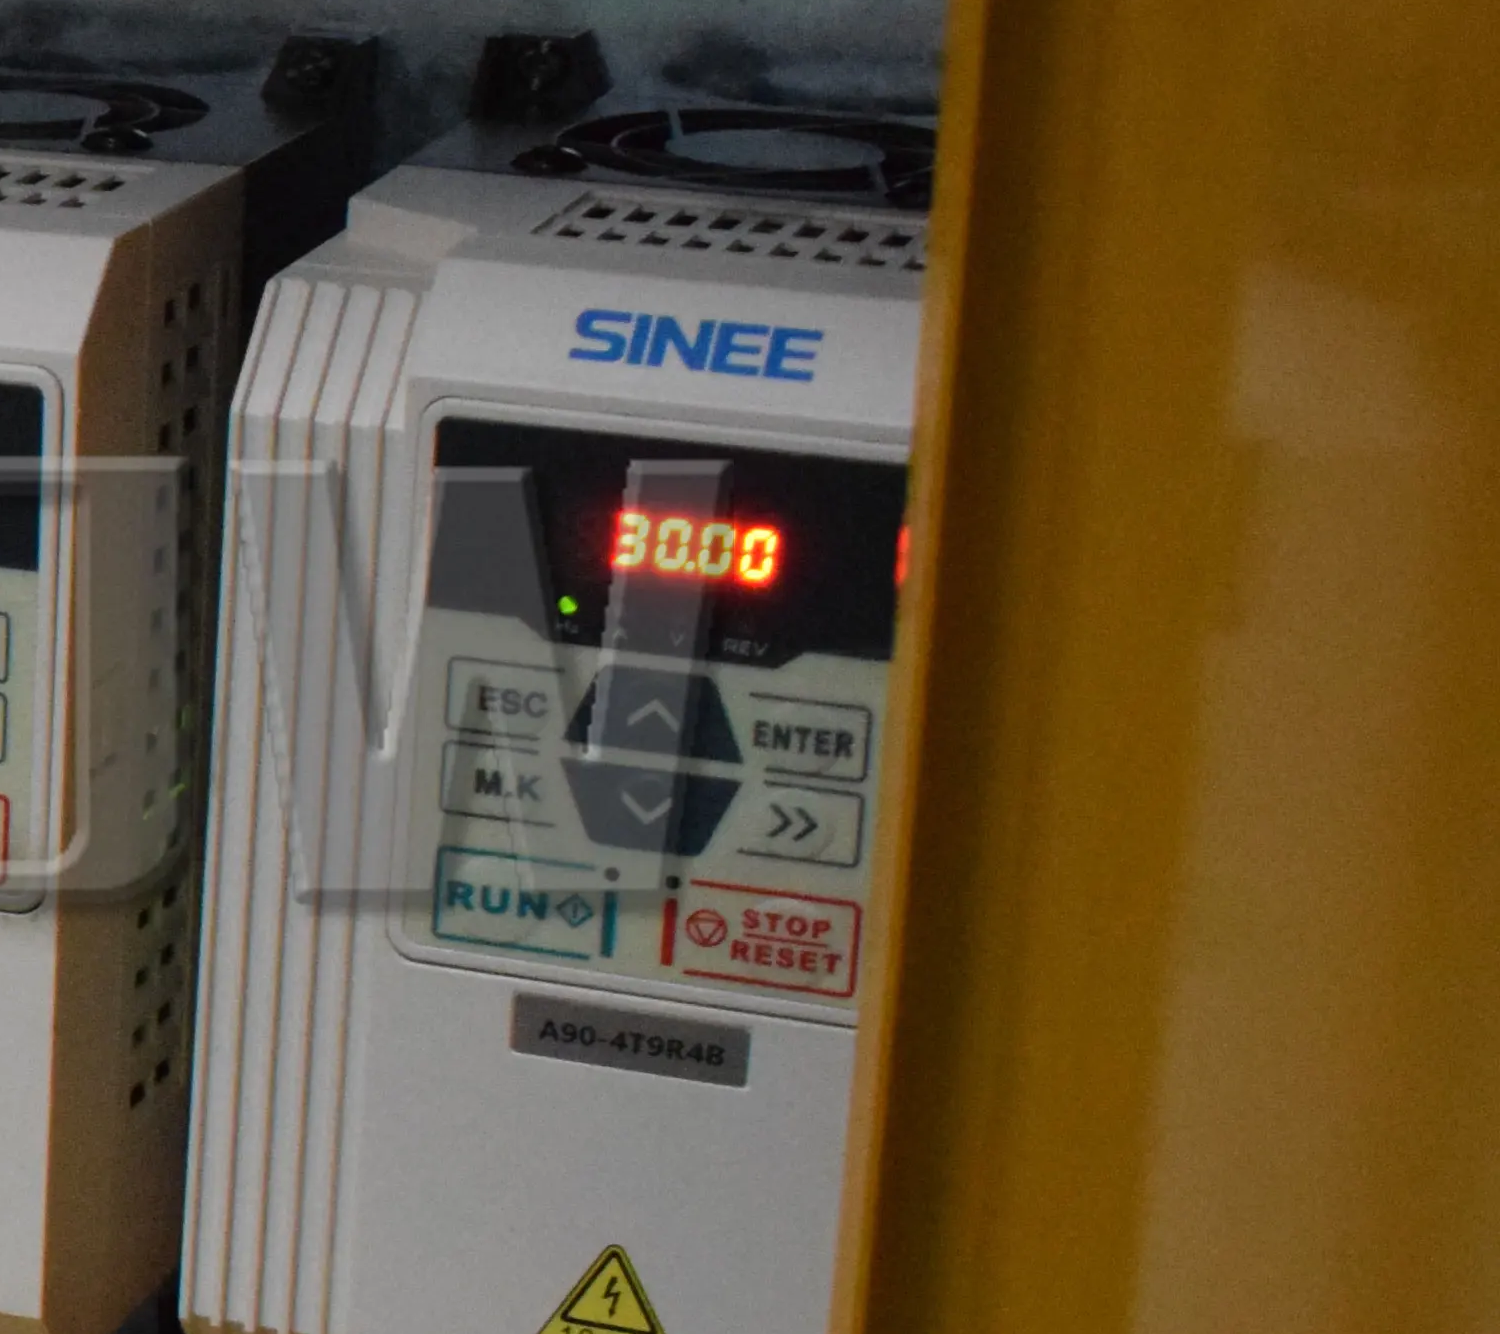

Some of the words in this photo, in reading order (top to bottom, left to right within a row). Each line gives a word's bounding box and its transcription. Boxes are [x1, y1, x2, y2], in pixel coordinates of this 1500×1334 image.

[569, 309, 825, 382] SINEE
[613, 511, 780, 584] 30.00
[722, 636, 769, 657] REV
[477, 684, 548, 718] ESC
[752, 720, 855, 759] ENTER
[474, 768, 542, 802] M.K
[446, 880, 548, 922] RUN
[742, 908, 832, 940] STOP
[730, 940, 842, 975] RESET
[539, 1017, 725, 1067] A90-4T9R4B
